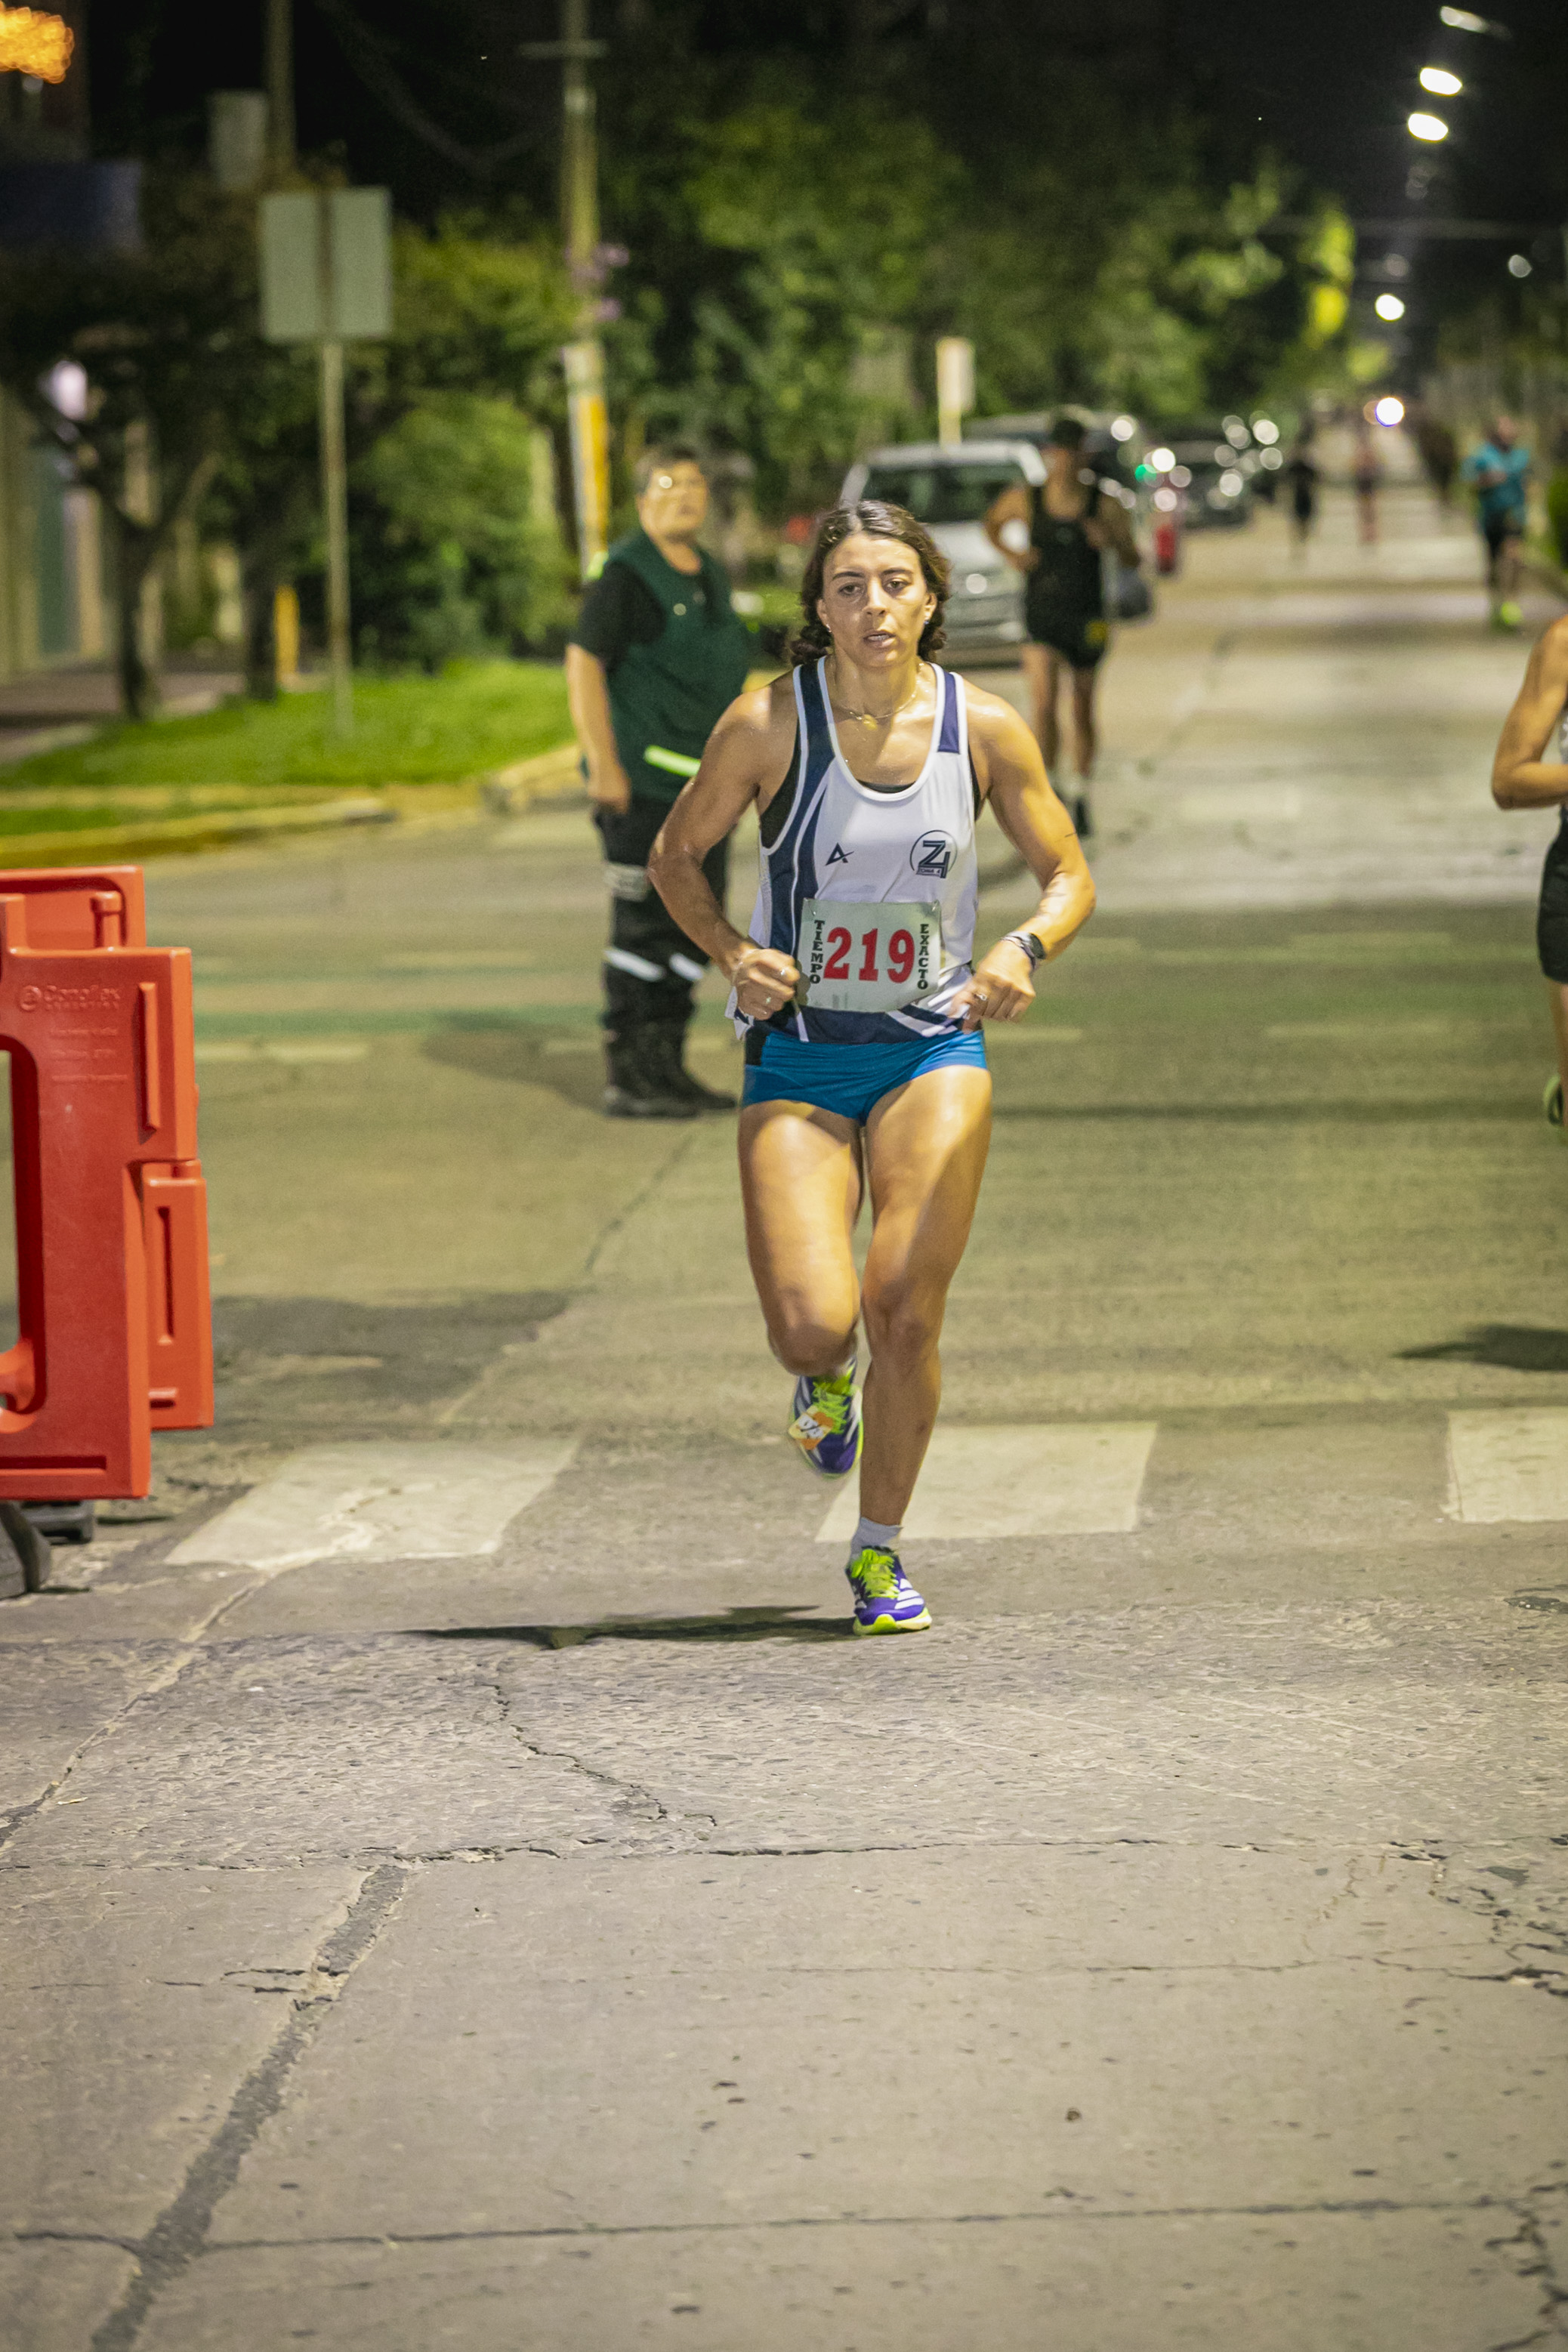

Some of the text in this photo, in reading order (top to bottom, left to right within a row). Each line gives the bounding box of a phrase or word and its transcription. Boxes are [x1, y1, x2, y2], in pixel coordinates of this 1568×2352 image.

[809, 919, 826, 984] TIEMPO
[823, 927, 915, 983] 219
[917, 924, 930, 989] EXACTO
